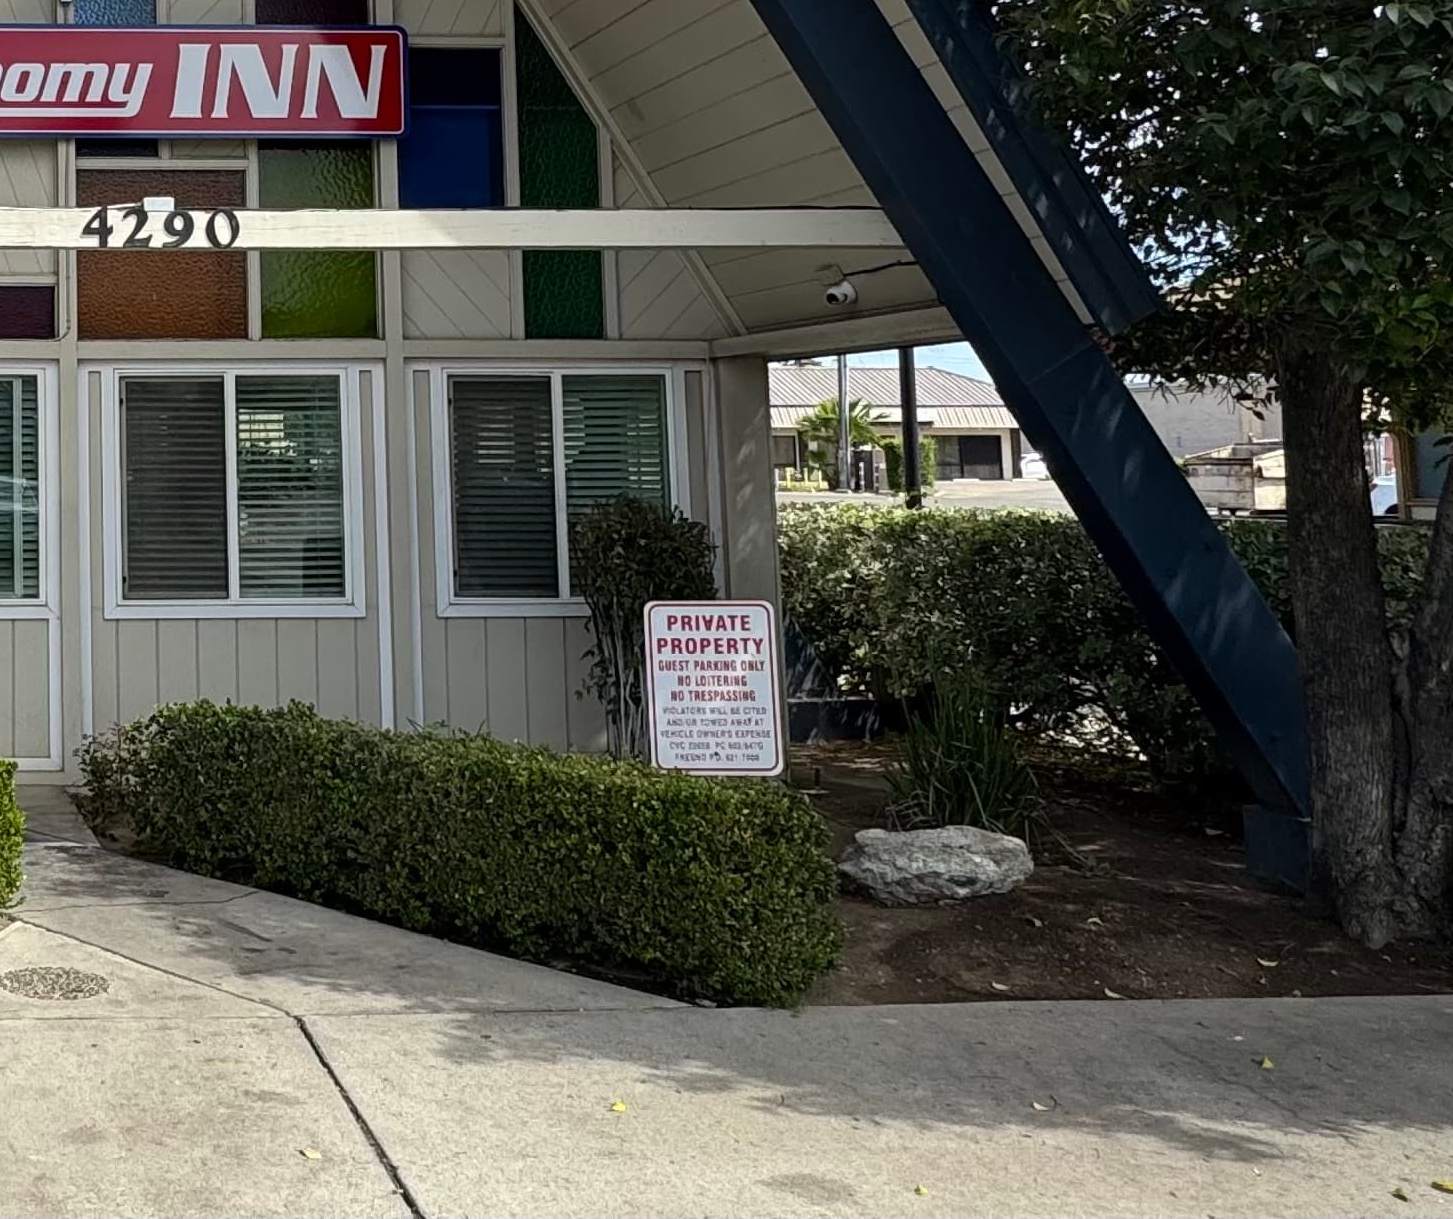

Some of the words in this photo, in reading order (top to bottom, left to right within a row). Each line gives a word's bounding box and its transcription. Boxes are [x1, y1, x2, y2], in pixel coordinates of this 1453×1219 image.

[169, 43, 388, 119] INN
[80, 205, 241, 249] 4290
[666, 614, 752, 632] PRIVATE
[656, 637, 764, 655] PROPERTY
[658, 660, 690, 673] GUEST
[693, 660, 738, 672] PARKING
[740, 659, 766, 672] ONLY
[677, 674, 692, 687] NO
[695, 674, 748, 687] LOITERING
[670, 690, 685, 702] NO
[688, 689, 756, 702] TRESPASSING
